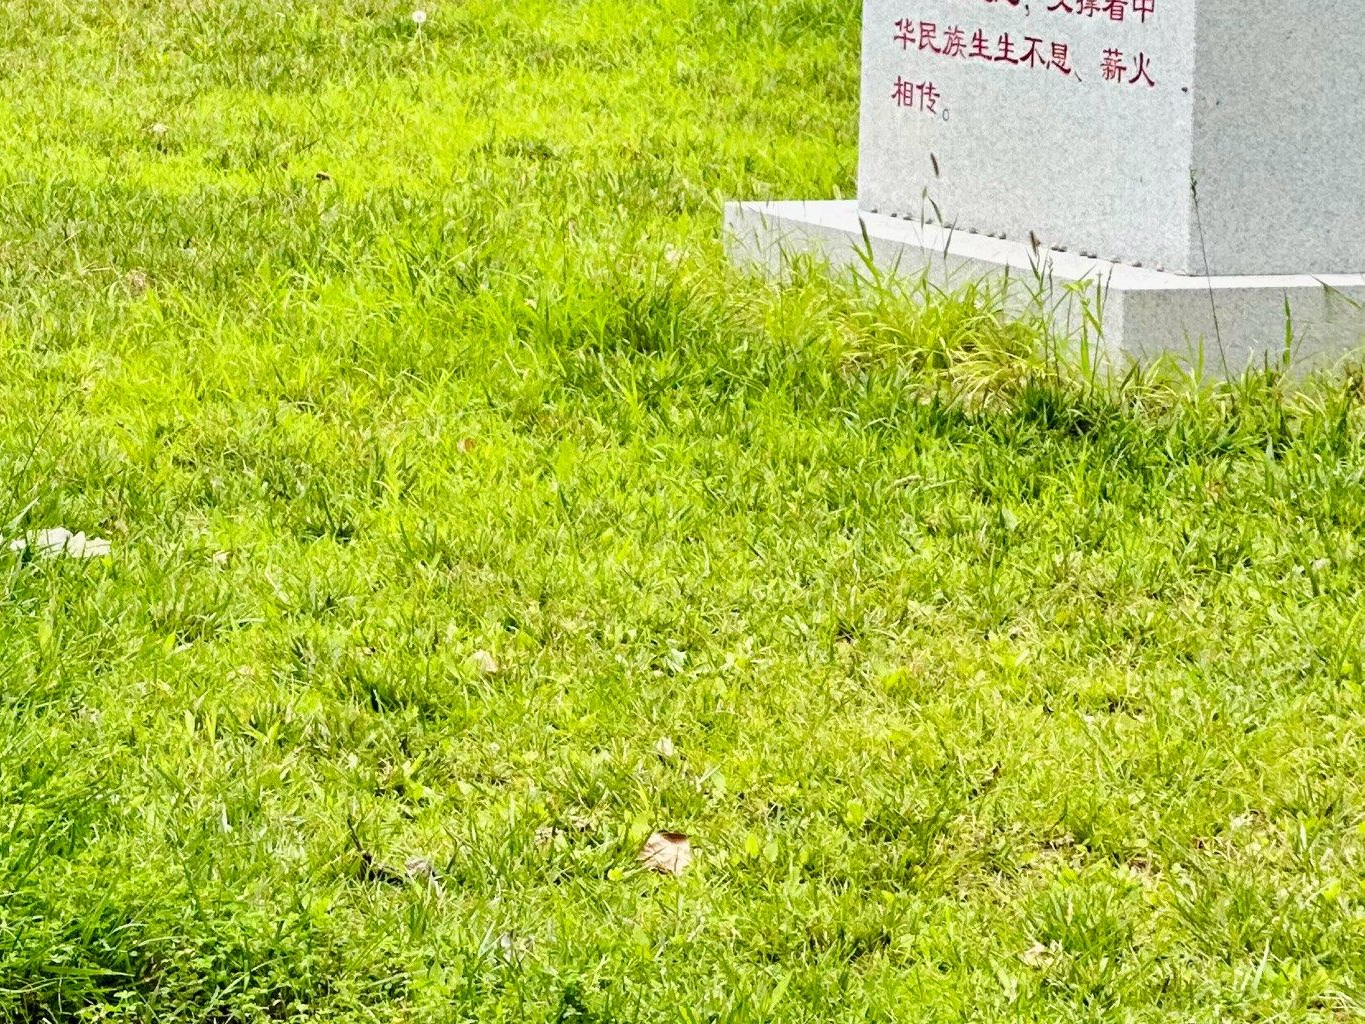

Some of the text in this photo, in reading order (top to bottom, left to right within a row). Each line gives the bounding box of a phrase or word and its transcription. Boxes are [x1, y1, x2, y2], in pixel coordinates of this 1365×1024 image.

[893, 17, 1156, 87] 华民族生生不息、薪火
[891, 75, 950, 122] 相传。
